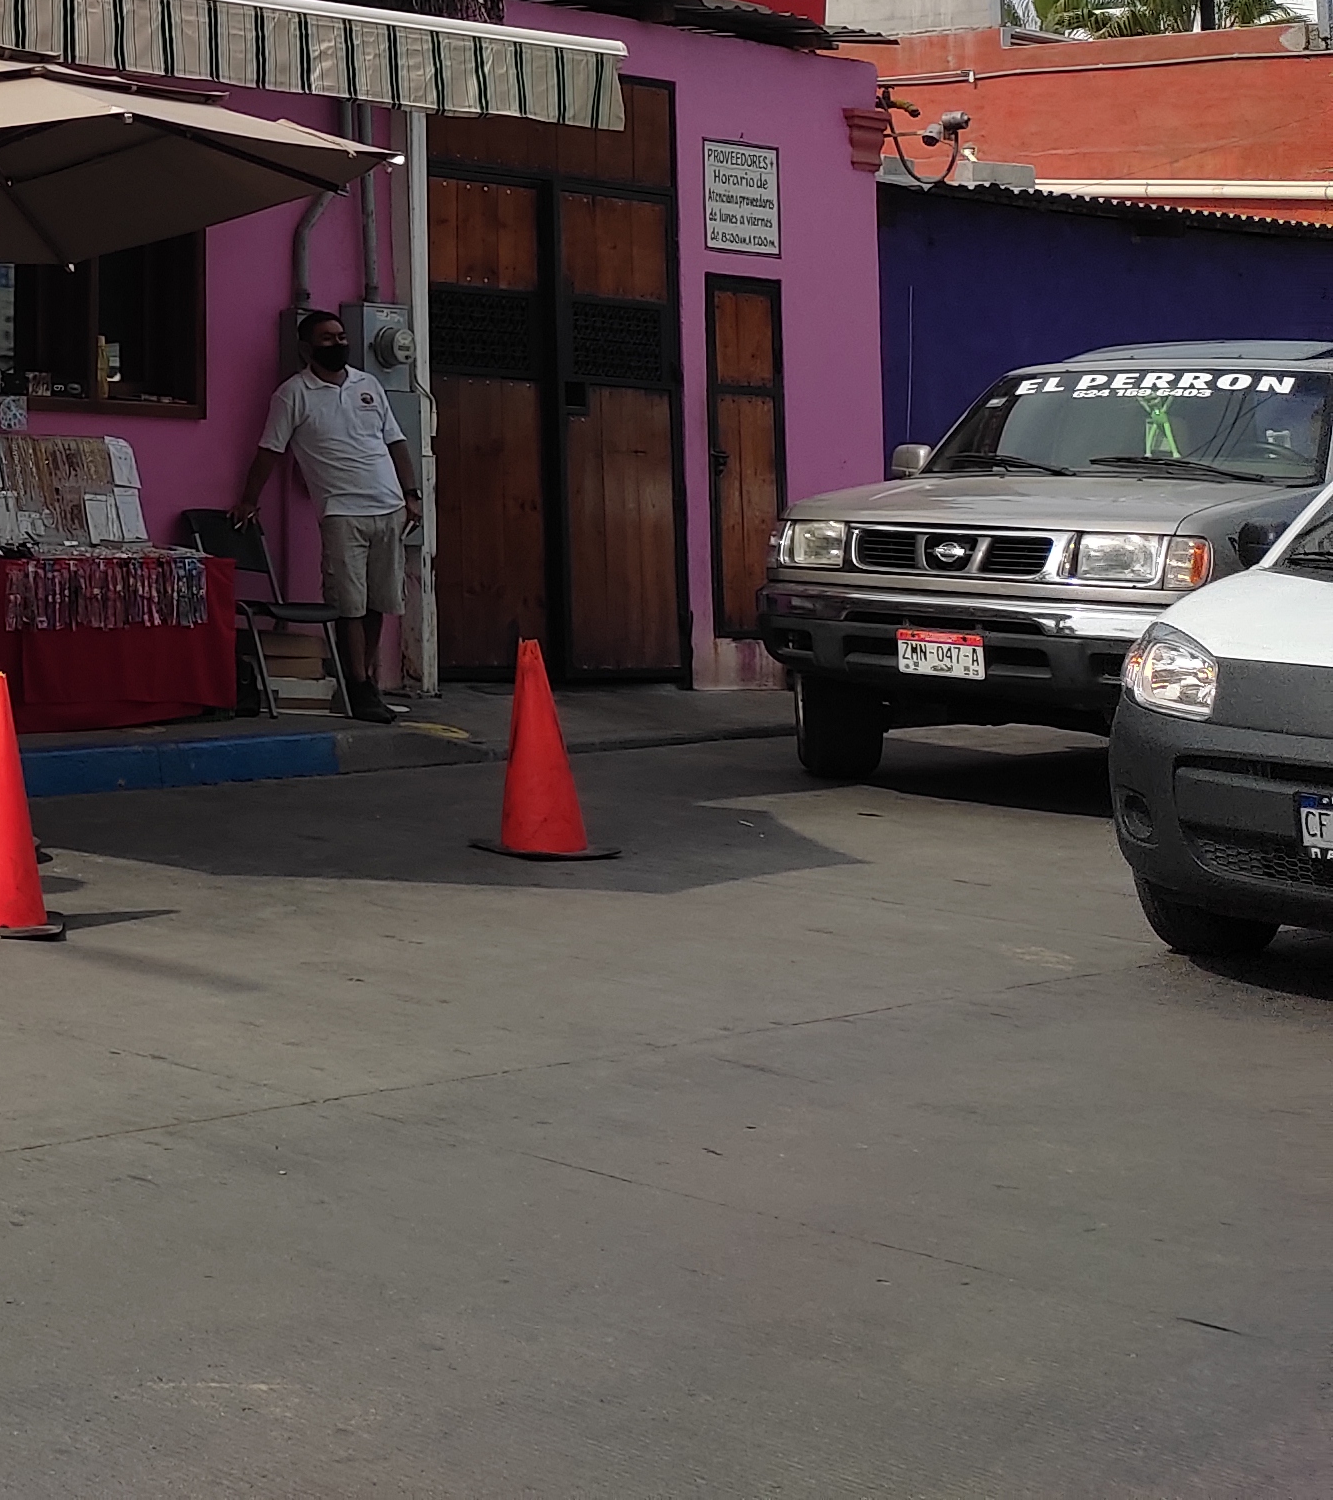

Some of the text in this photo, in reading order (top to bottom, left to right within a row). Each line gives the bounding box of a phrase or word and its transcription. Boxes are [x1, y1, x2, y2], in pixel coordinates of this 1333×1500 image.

[707, 148, 768, 170] PROVEEDORES
[713, 169, 769, 190] Horario de
[708, 208, 773, 228] de lunes a viernes
[1015, 372, 1296, 396] EL PERRON
[1072, 389, 1110, 398] 624
